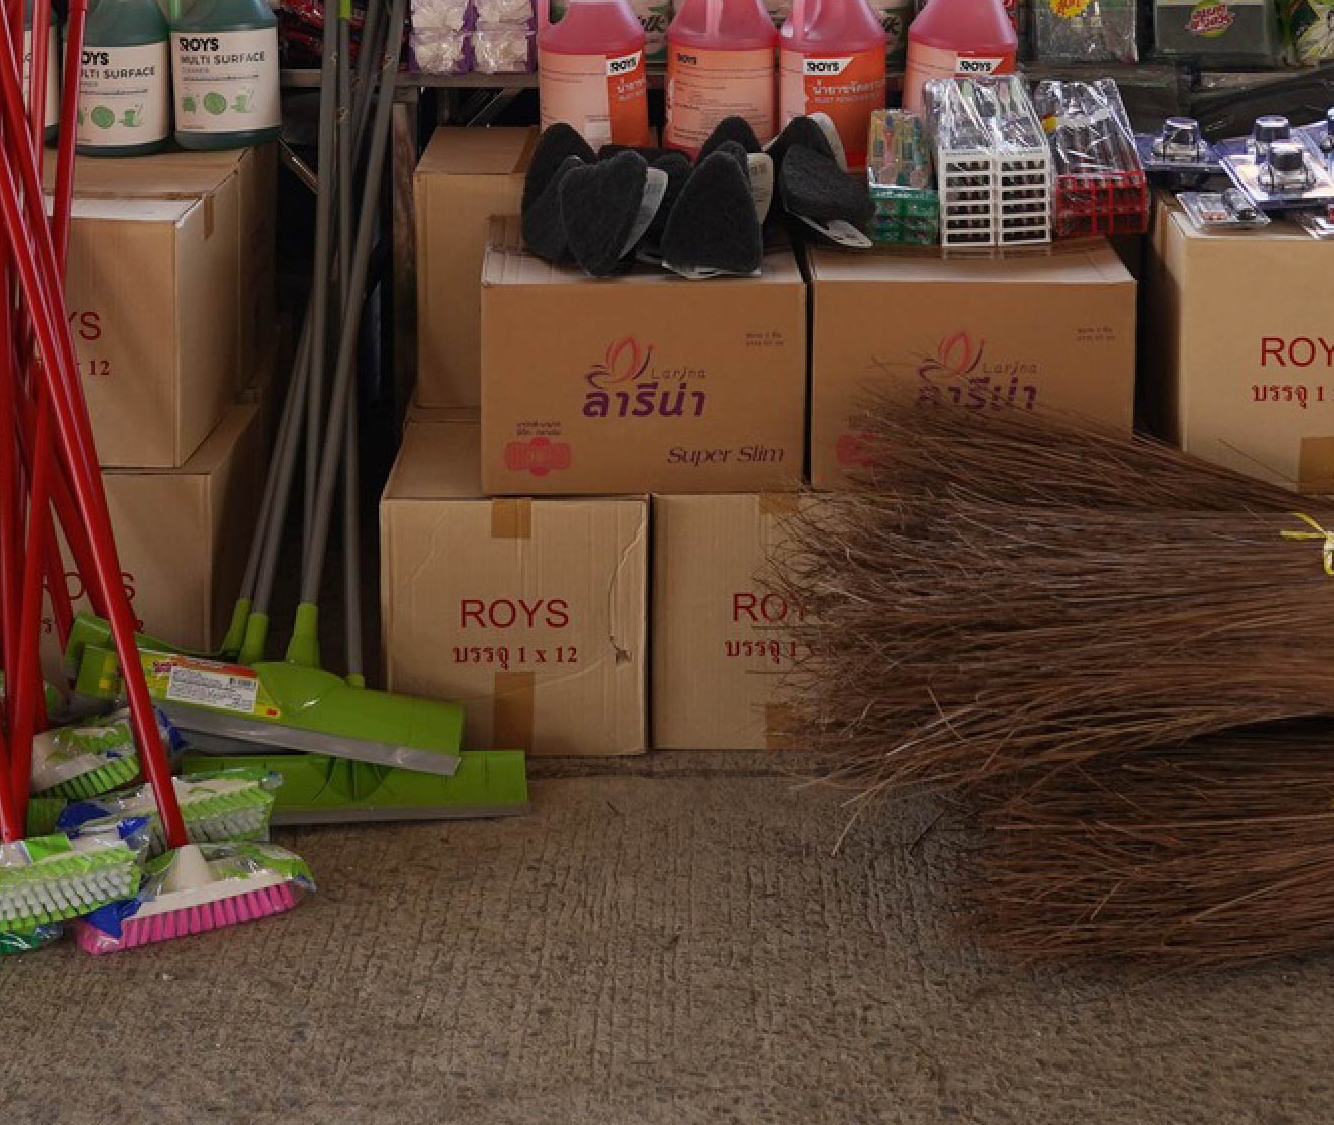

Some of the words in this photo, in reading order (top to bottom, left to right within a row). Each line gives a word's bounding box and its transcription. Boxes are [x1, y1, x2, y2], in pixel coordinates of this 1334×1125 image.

[179, 36, 219, 52] ROYS
[81, 51, 110, 66] OYS
[181, 55, 211, 66] MULTI
[214, 51, 265, 65] SURFACE
[806, 60, 840, 73] ROYS
[959, 59, 993, 73] ROYS
[103, 65, 156, 80] SURFACE
[582, 382, 706, 418] ลารีน่า
[1251, 383, 1308, 410] บรรจุ
[1317, 386, 1326, 402] 1
[667, 446, 732, 466] Super
[737, 445, 785, 463] Slim
[459, 598, 570, 629] ROYS
[732, 593, 805, 622] ROY
[452, 645, 509, 670] บรรจุ
[519, 647, 528, 663] 1
[535, 651, 548, 663] x
[555, 646, 578, 663] 12
[724, 640, 780, 665] บรรจุ
